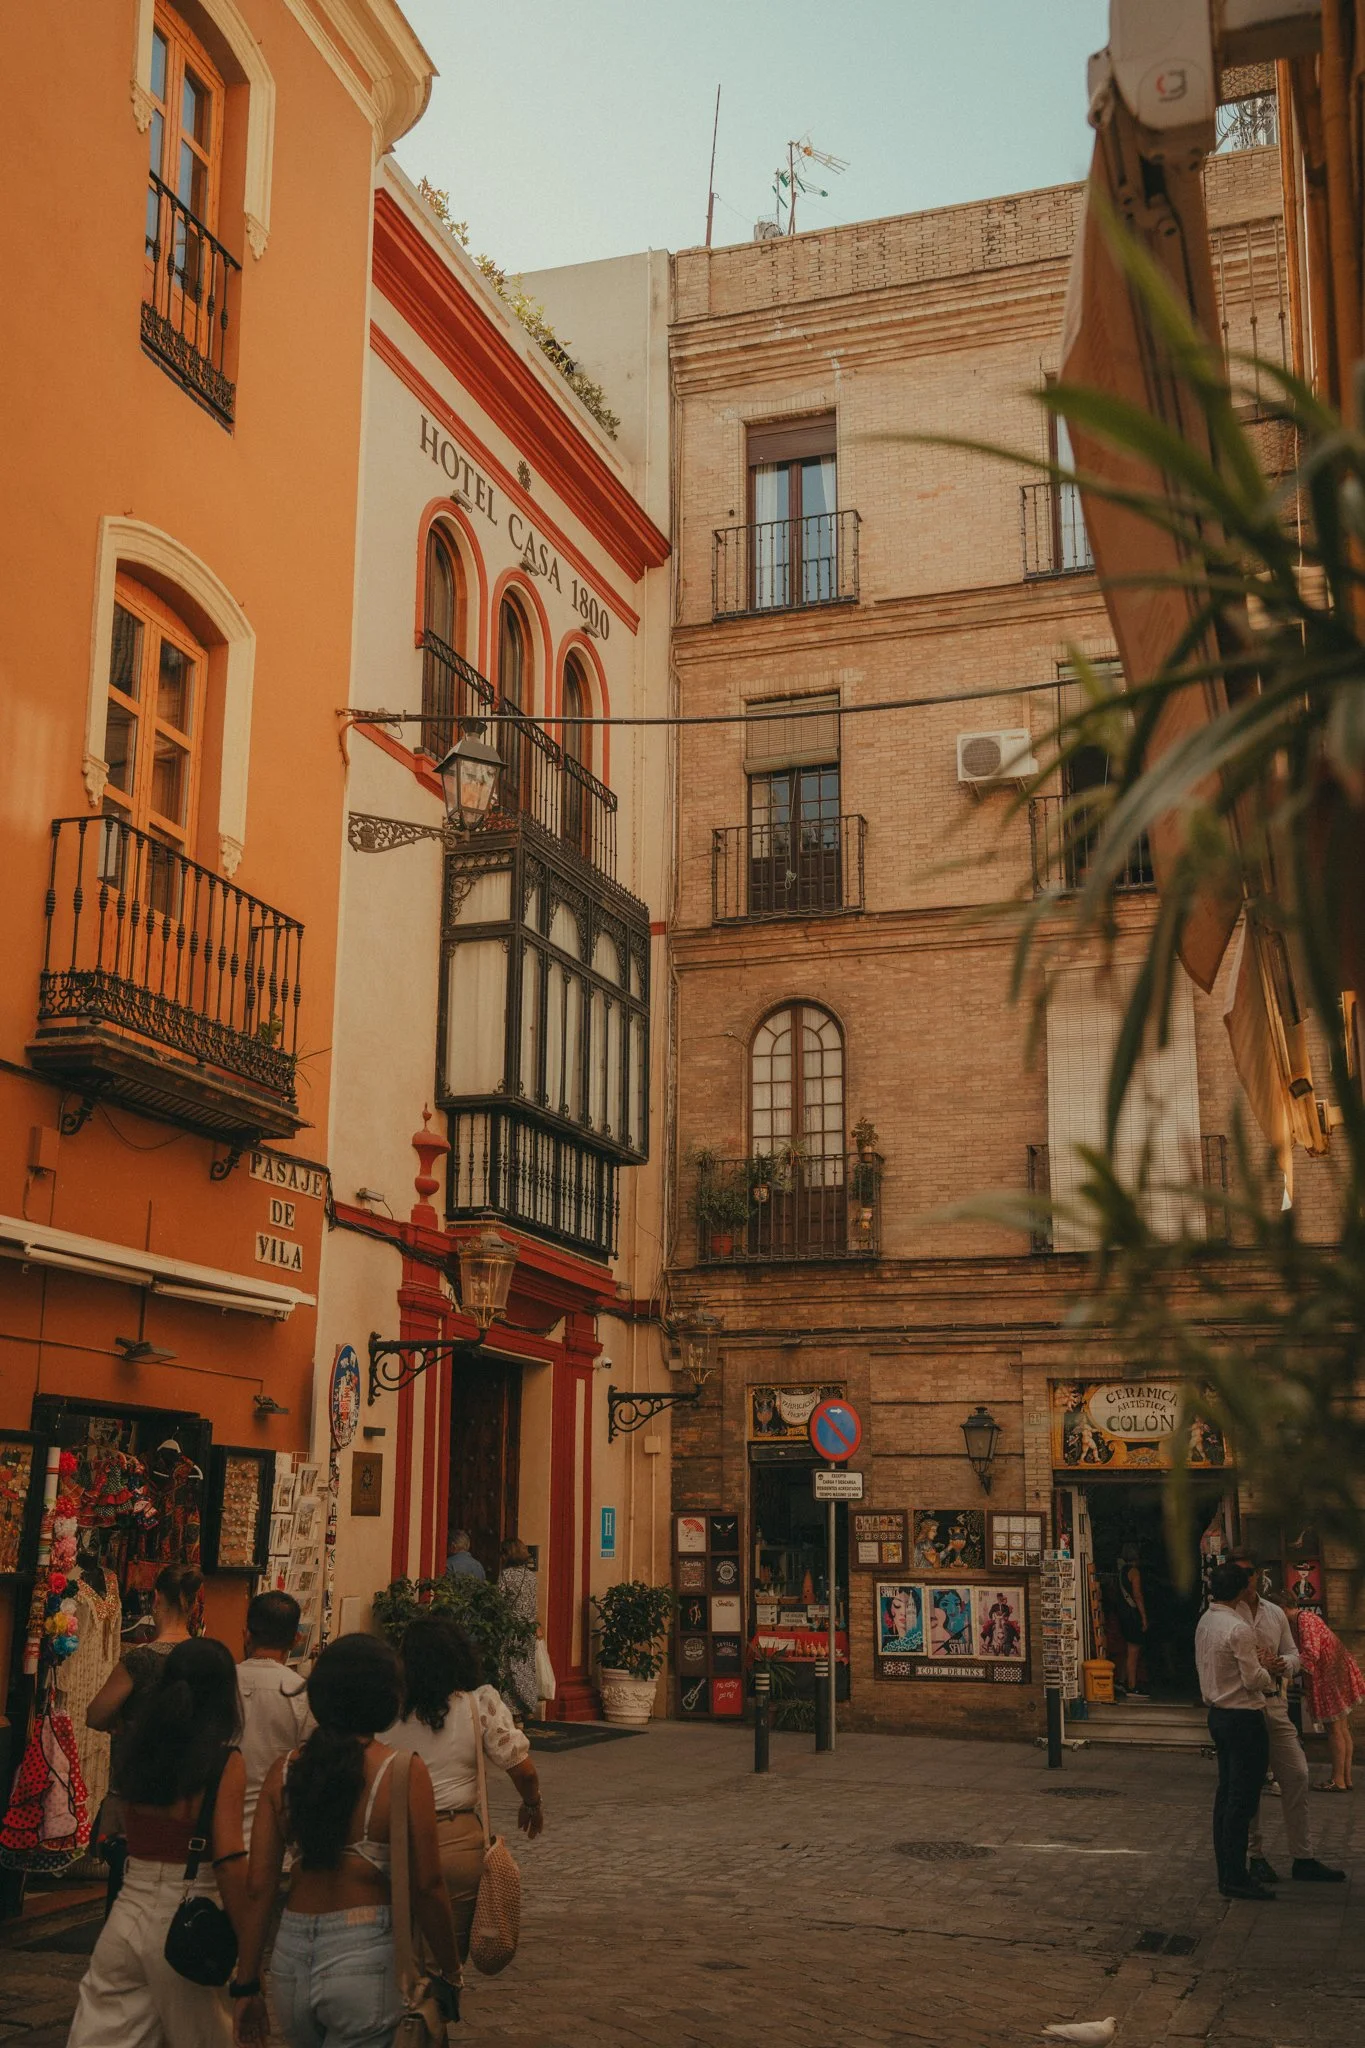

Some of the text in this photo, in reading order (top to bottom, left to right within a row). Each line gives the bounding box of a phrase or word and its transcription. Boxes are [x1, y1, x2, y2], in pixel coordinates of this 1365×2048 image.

[420, 415, 610, 640] HOTEL CASA 1800
[250, 1152, 323, 1197] PASAJE
[272, 1200, 295, 1228] DE
[257, 1235, 302, 1270] VILA
[1106, 1387, 1178, 1407] CERAMICA
[1106, 1411, 1175, 1432] COLÓN
[604, 1512, 612, 1536] H
[716, 1641, 738, 1649] SEVILLA
[920, 1666, 981, 1677] COLD DRINKS
